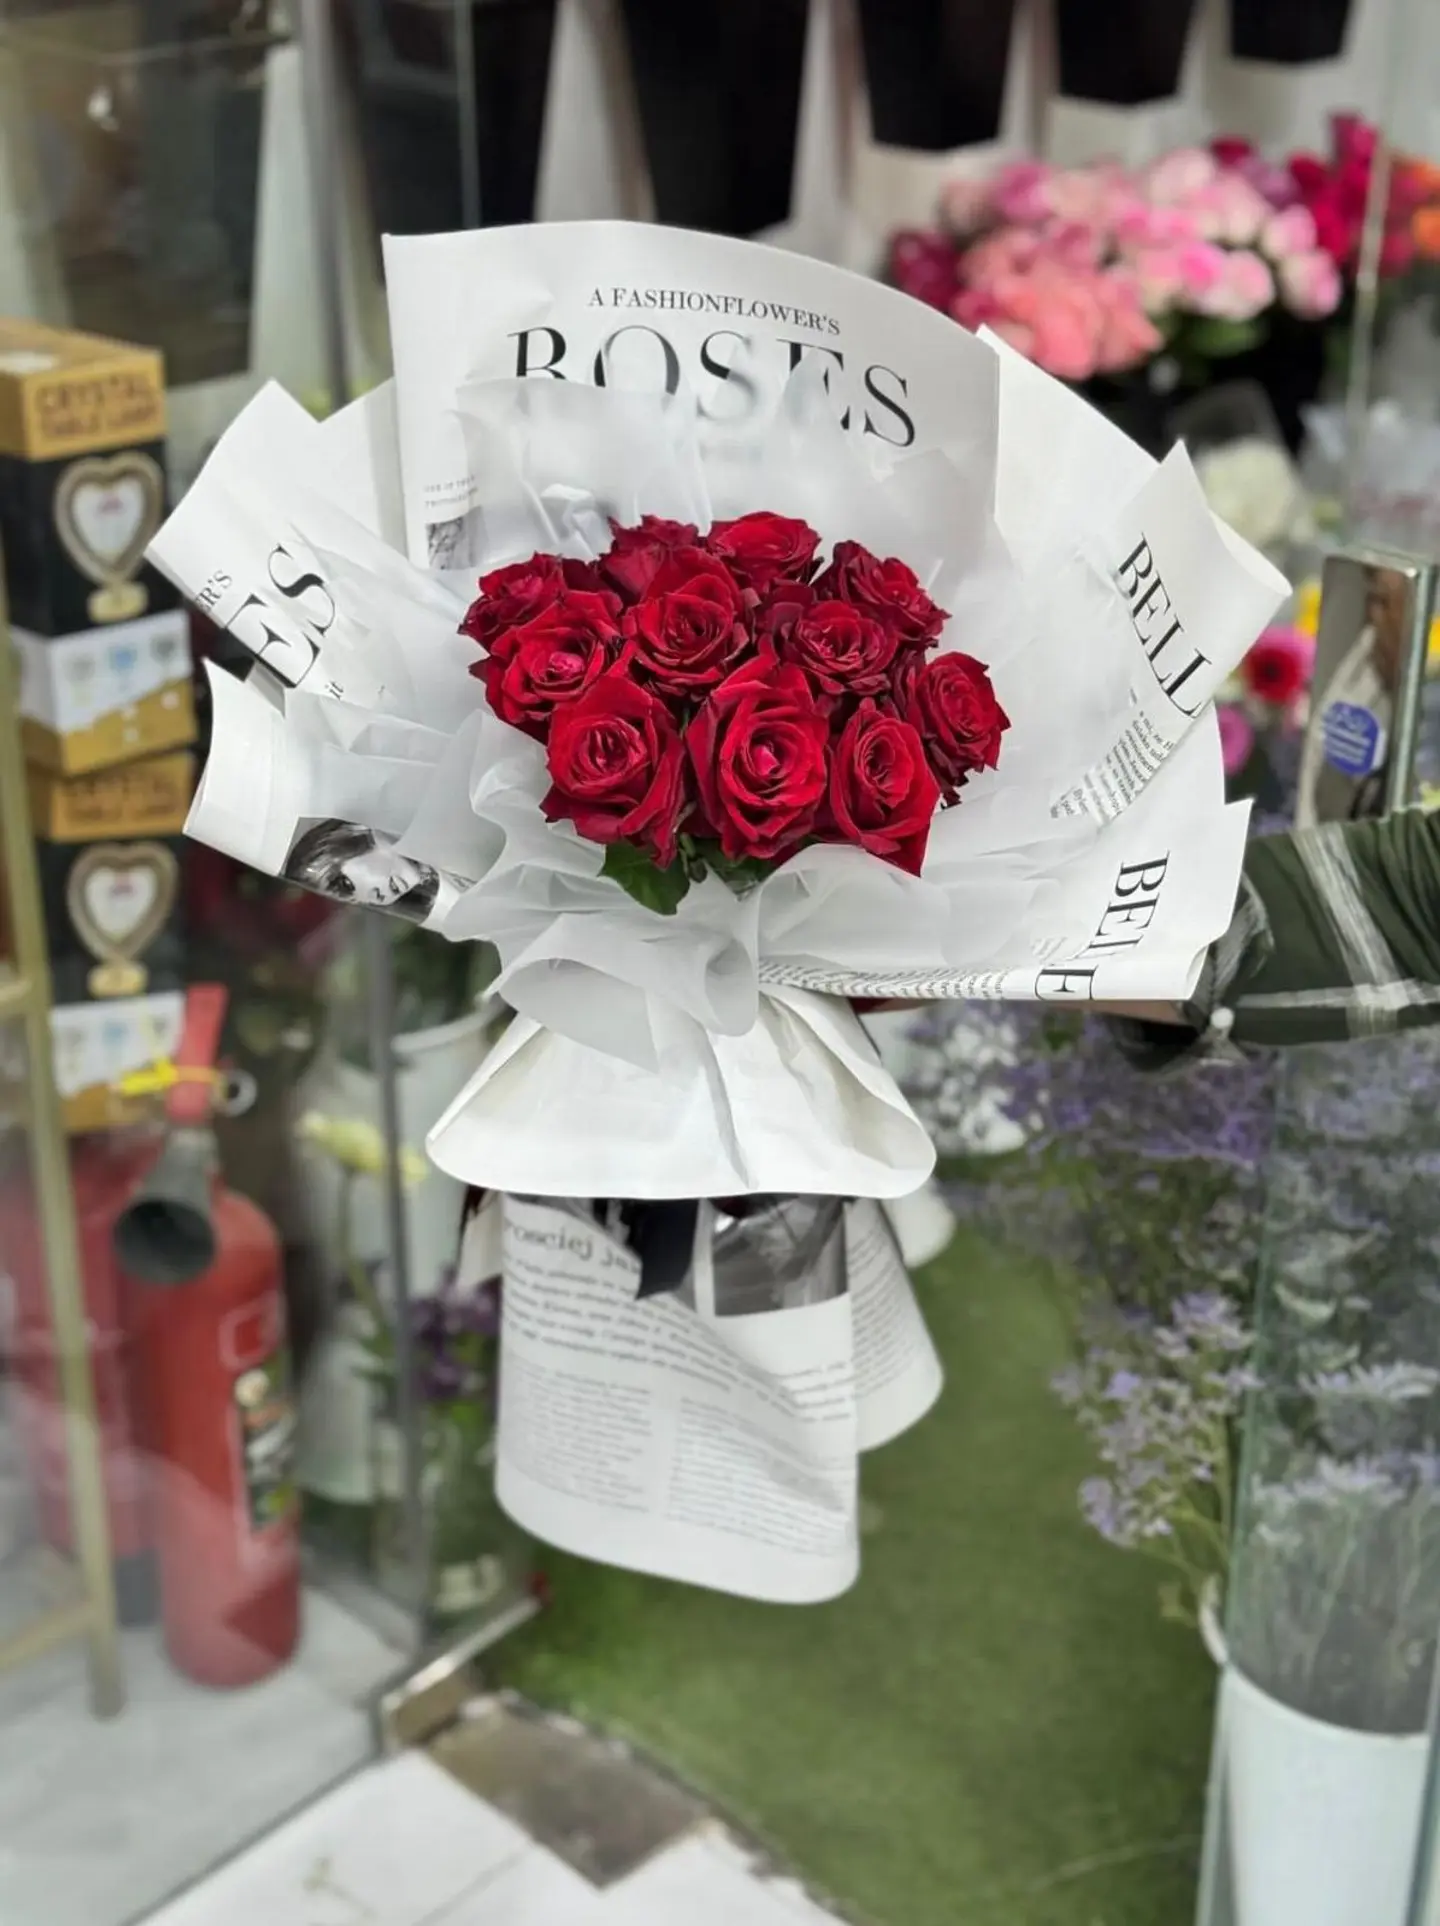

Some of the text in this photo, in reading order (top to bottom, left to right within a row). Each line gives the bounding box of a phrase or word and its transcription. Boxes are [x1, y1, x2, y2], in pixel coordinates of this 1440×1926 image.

[588, 287, 841, 335] A FASHIONFLOWER'S
[223, 542, 336, 685] ES
